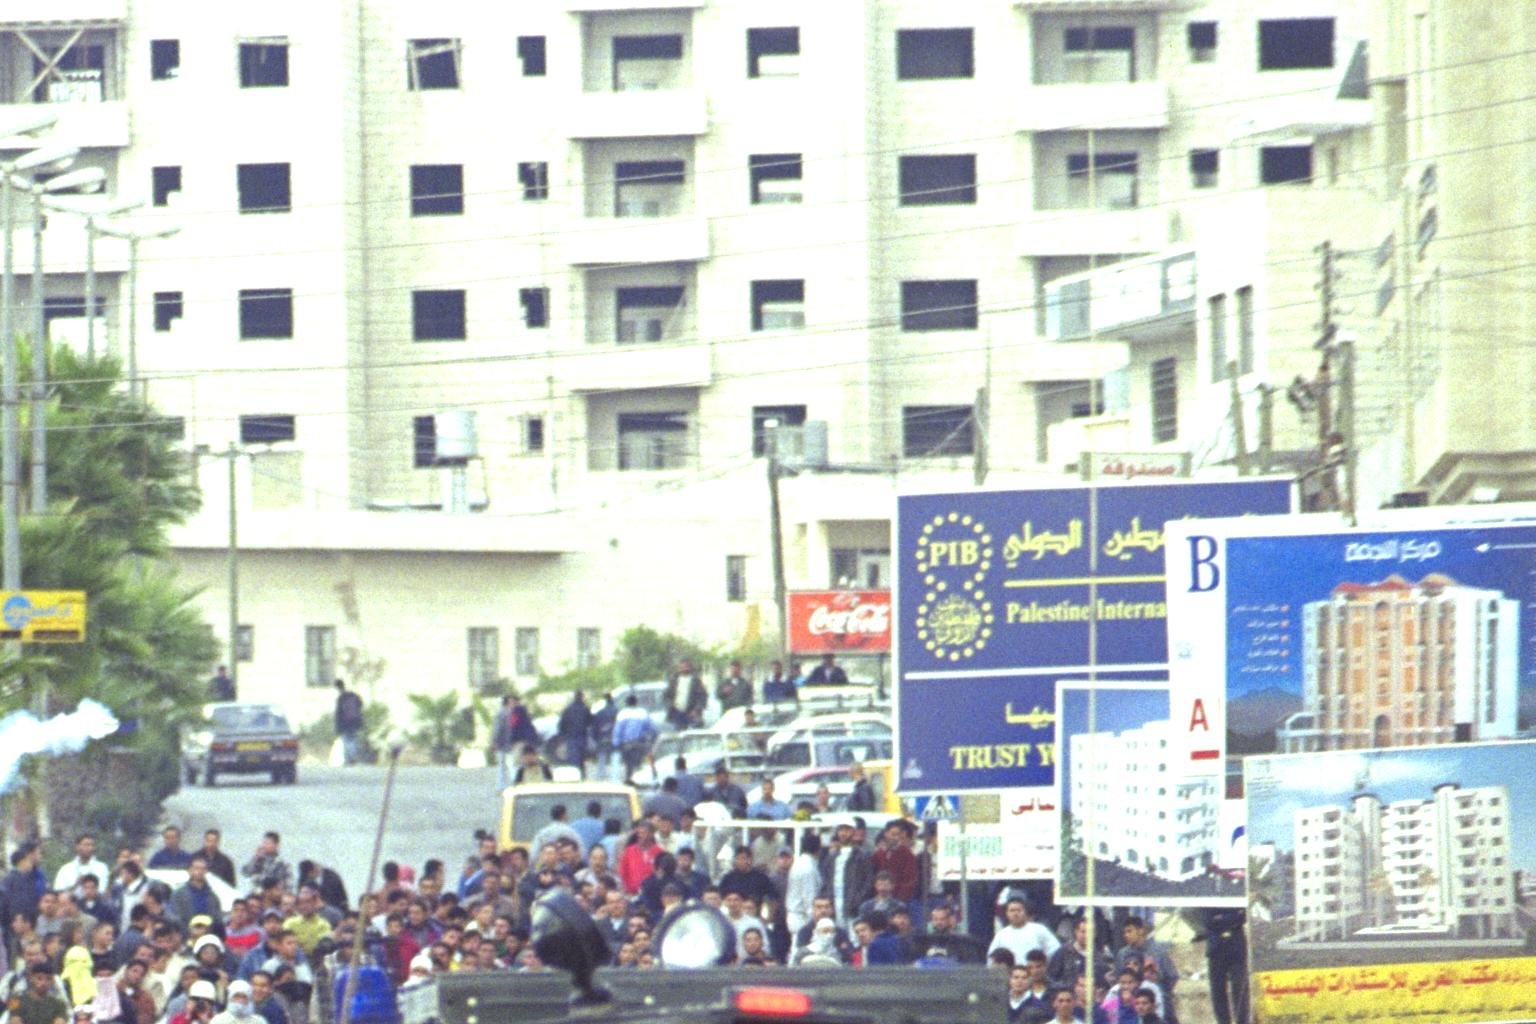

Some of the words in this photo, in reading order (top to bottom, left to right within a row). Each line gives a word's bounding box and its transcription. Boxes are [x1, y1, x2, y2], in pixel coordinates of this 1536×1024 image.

[929, 540, 980, 567] PIB
[1187, 535, 1221, 593] B
[1007, 600, 1091, 624] Palestine
[1096, 598, 1168, 620] Interna
[1189, 699, 1210, 732] A
[949, 744, 1031, 770] TRUST
